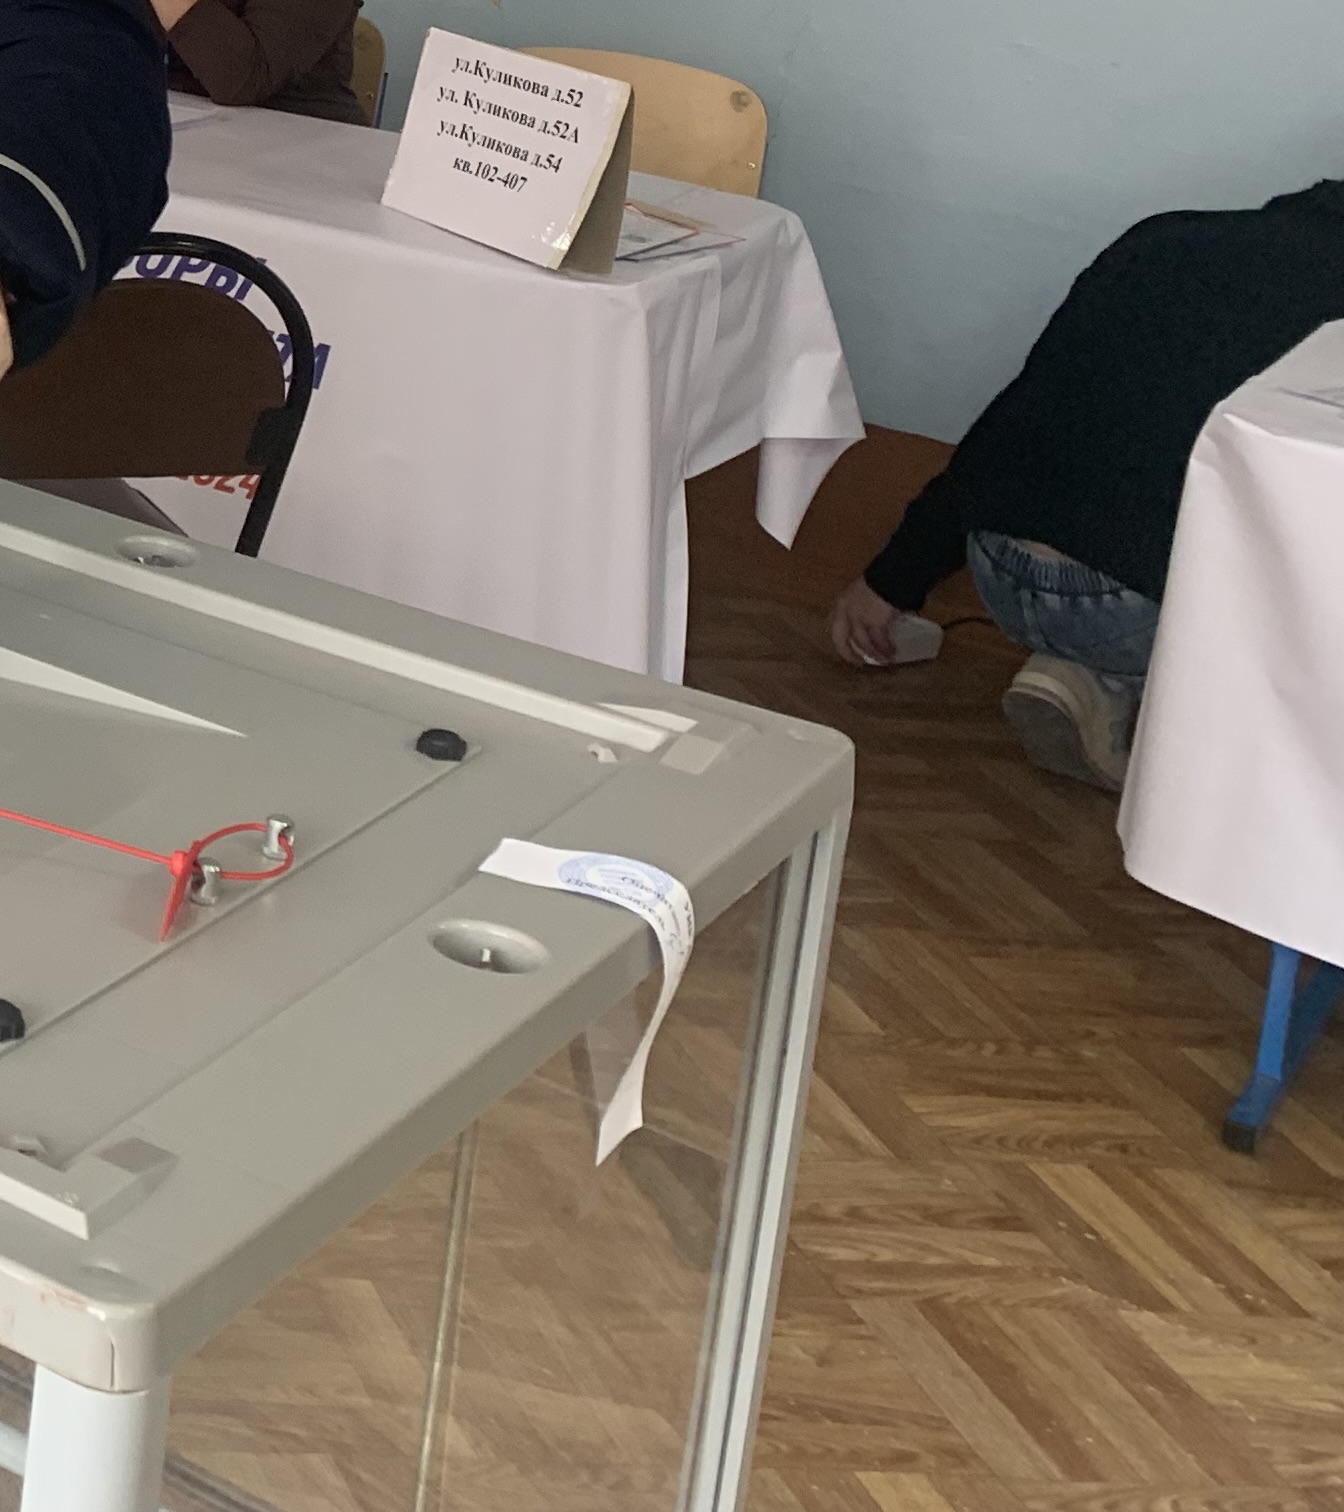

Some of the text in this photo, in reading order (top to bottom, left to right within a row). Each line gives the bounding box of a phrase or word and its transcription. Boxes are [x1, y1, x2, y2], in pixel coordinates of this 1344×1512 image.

[451, 54, 584, 109] ул.Куликова д.52
[436, 84, 580, 145] ул. Куликова д.52А
[436, 117, 563, 174] ул.Куликова д.54
[451, 156, 528, 194] кв.102-407
